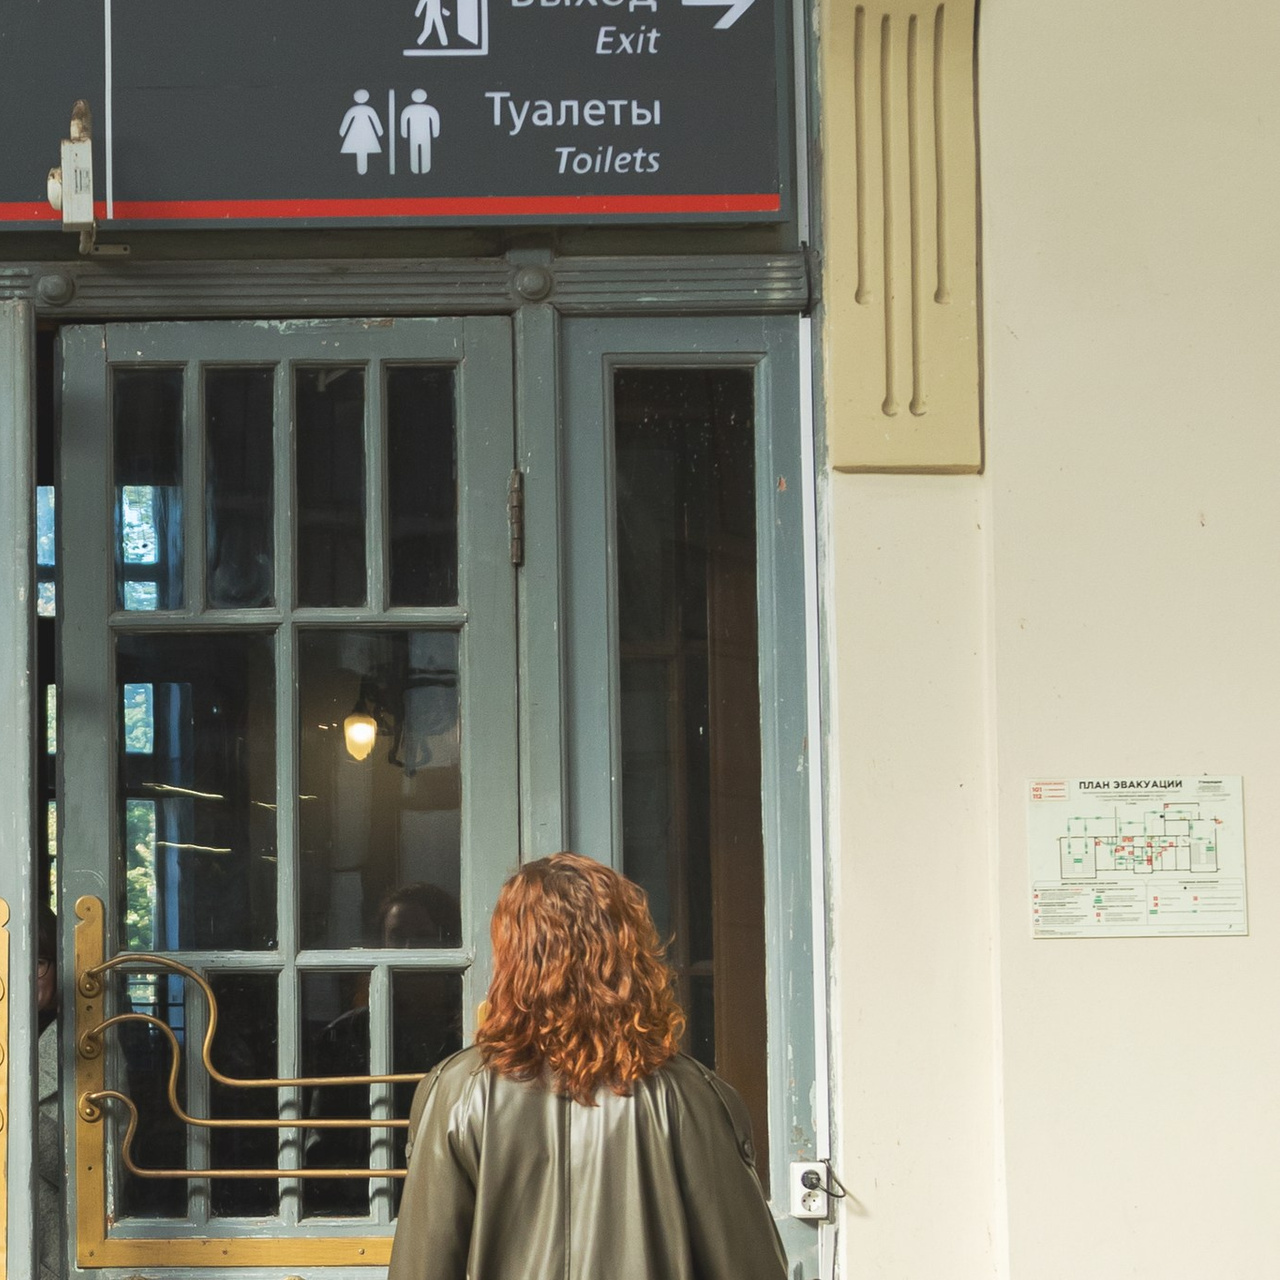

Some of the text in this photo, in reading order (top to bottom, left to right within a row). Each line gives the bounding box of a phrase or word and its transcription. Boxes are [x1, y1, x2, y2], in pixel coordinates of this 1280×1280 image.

[595, 25, 661, 55] Exit
[484, 91, 662, 136] Туалеты
[554, 145, 661, 175] Toilets
[1078, 780, 1183, 790] ПЛАН ЭВАКУАЦИИ
